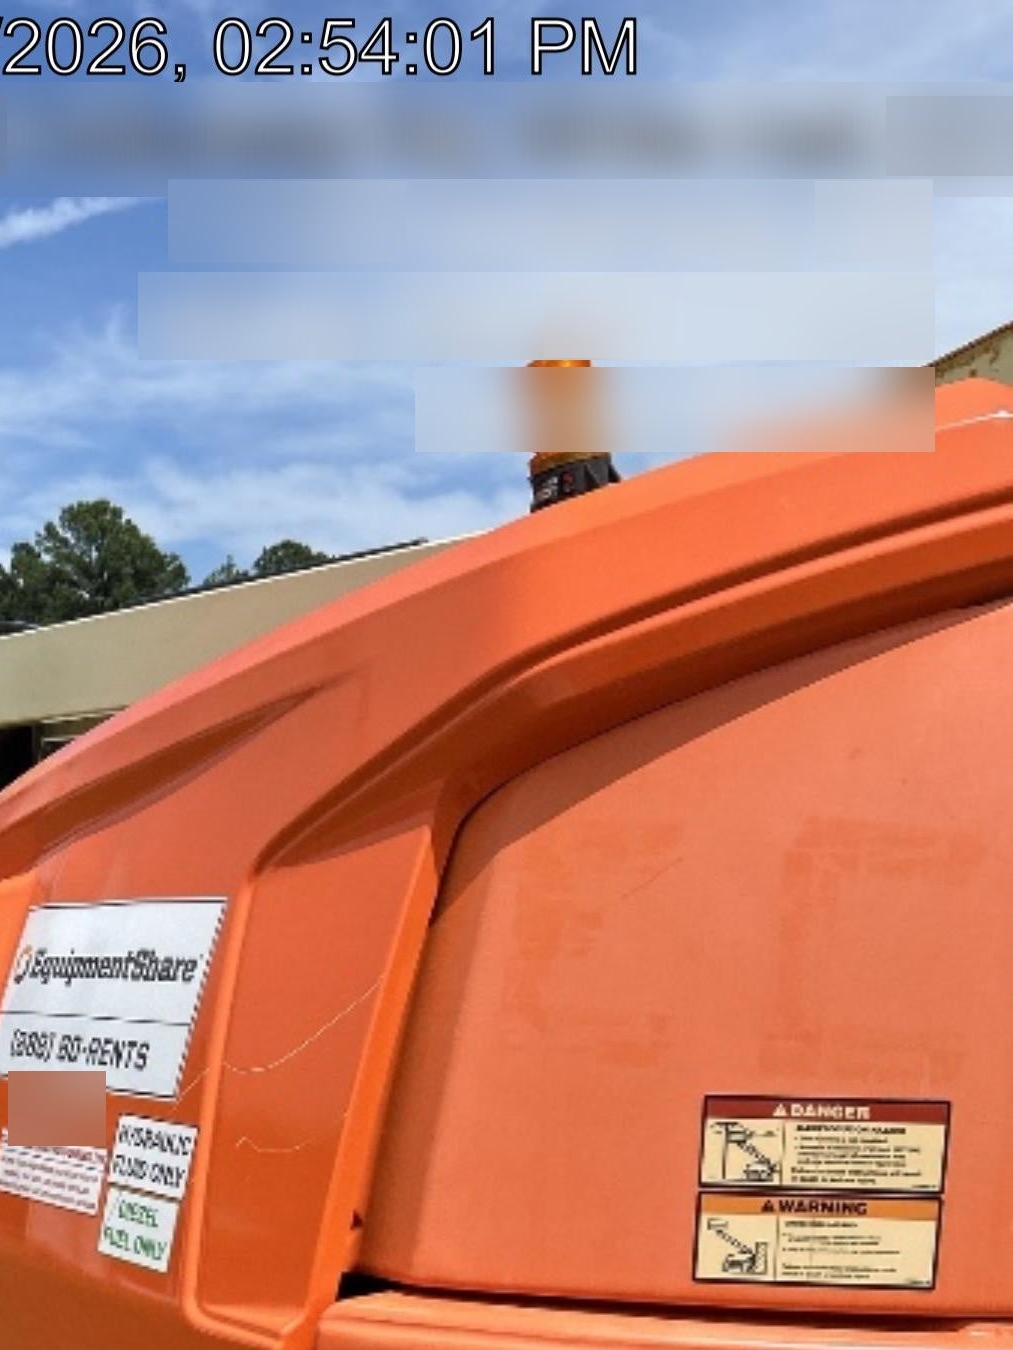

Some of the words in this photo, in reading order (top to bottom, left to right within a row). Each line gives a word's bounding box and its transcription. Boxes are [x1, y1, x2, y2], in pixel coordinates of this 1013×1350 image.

[29, 948, 198, 987] EquipmentShare
[790, 1103, 870, 1119] DANGER
[149, 1161, 186, 1189] ONLY
[778, 1200, 868, 1216] WARNING
